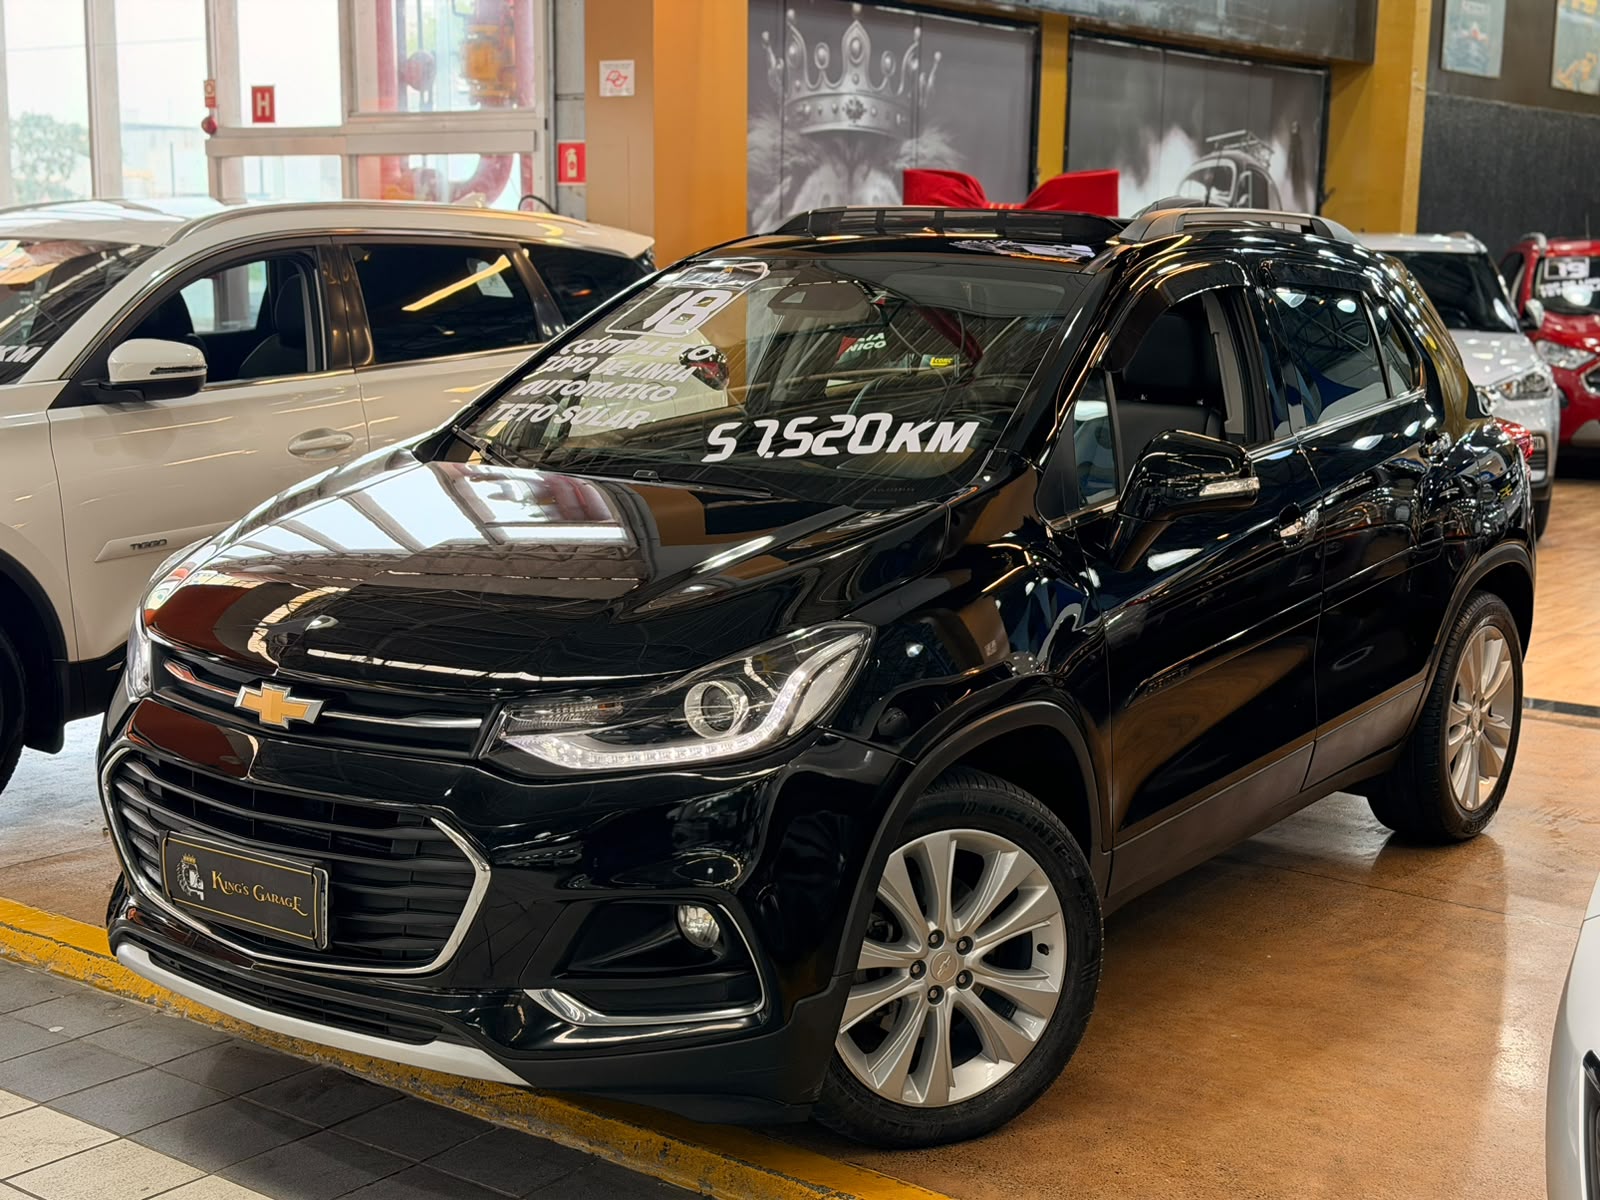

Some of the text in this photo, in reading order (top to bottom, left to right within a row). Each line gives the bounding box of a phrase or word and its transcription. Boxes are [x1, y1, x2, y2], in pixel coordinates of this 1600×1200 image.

[256, 92, 270, 117] H
[642, 290, 732, 335] 18
[560, 339, 717, 361] COMPLETO
[535, 356, 698, 383] TOPO DE LINHA
[512, 379, 678, 401] AUTOMATICO
[487, 403, 651, 430] TETO SOLAR
